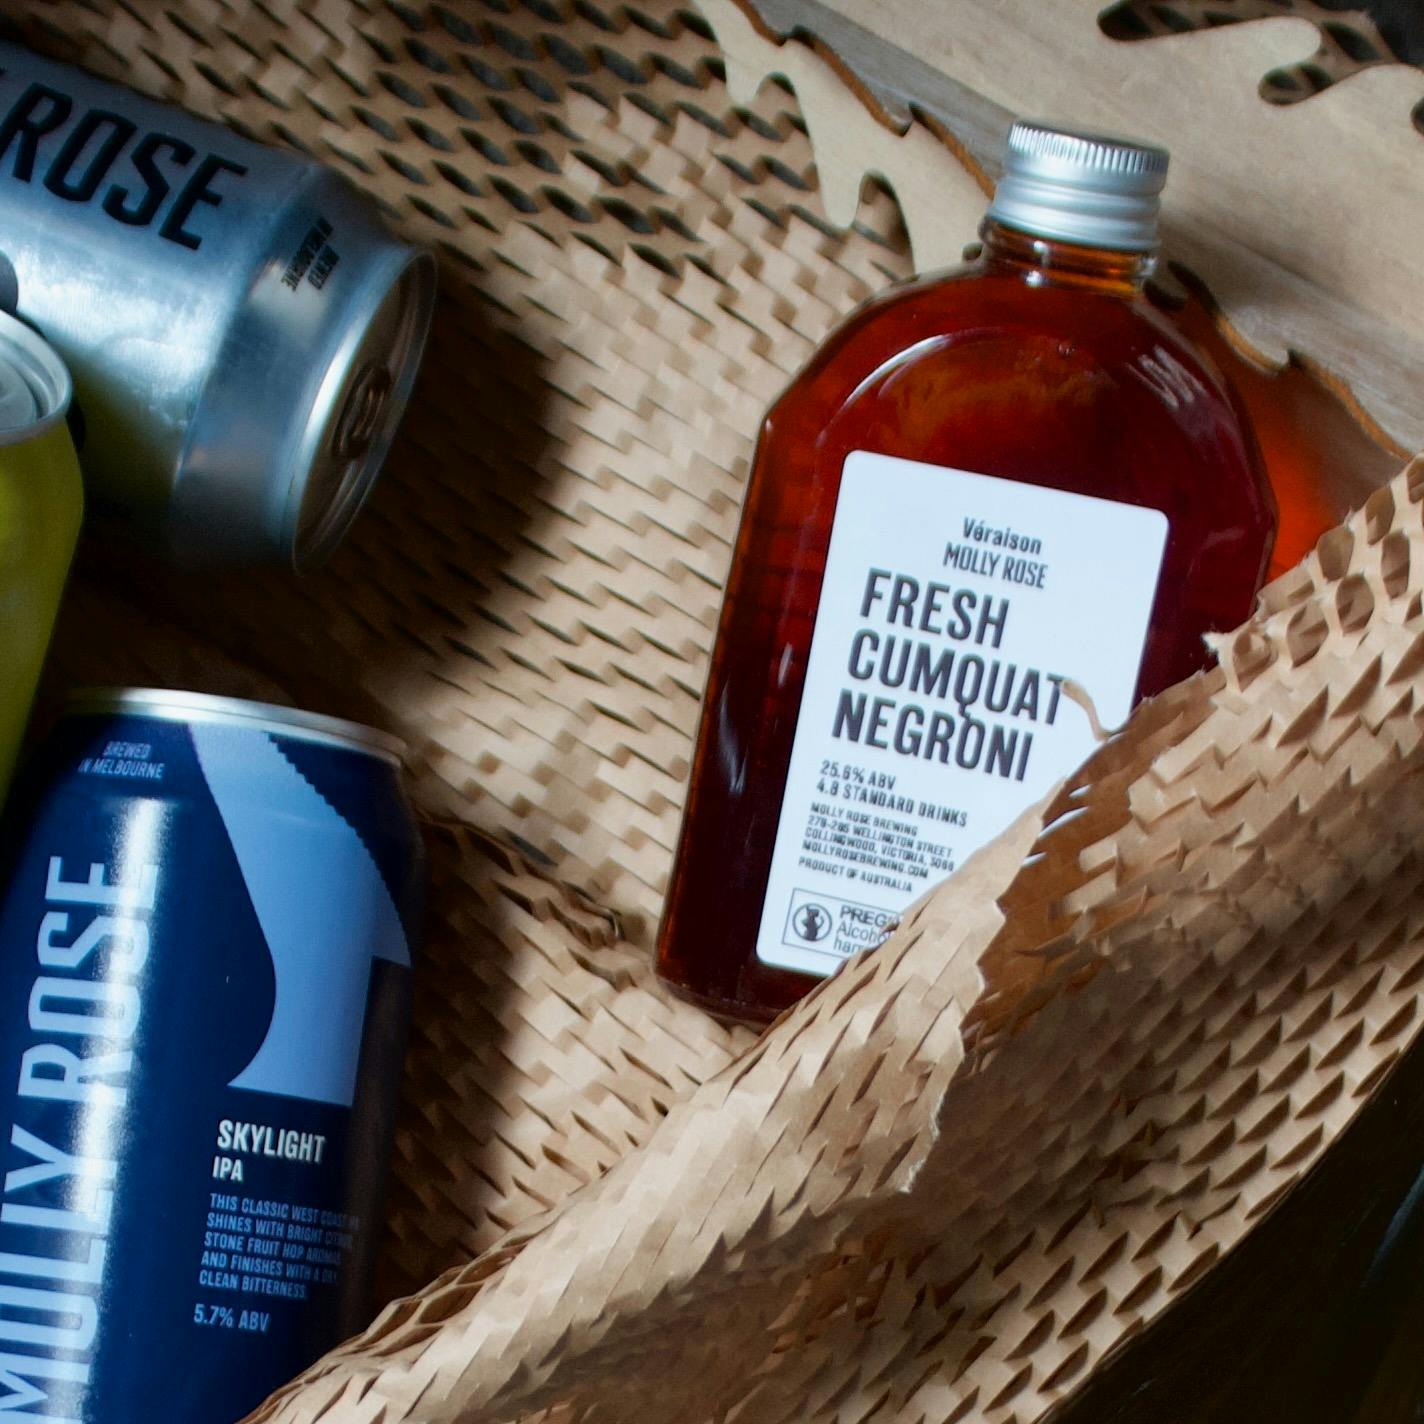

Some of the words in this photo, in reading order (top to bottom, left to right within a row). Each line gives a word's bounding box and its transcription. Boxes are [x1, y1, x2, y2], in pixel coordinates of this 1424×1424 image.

[963, 516, 1044, 556] Véraison
[942, 541, 1001, 579] MOLLY
[1001, 559, 1049, 590] ROSE
[859, 567, 1011, 649] FRESH
[847, 628, 1066, 727] CUMQUAT
[103, 741, 151, 759] BREWED
[831, 688, 1035, 783] NEGRONI
[92, 758, 164, 779] MELBOURNE
[868, 771, 896, 791] ABV
[810, 802, 844, 819] MOLLY
[846, 810, 872, 826] ROSE
[873, 817, 918, 837] BREWING
[817, 778, 839, 797] 4.8
[842, 784, 915, 815] STANDARD
[918, 801, 968, 828] DRINKS
[805, 827, 877, 855] COLLINGWOOD,
[881, 845, 928, 866] VICTORIA,
[853, 825, 914, 850] WELLINGTON
[916, 840, 953, 858] STREET
[799, 856, 844, 876] PRODUCT
[846, 867, 859, 880] OF
[860, 871, 912, 893] AUSTRALIA
[802, 840, 929, 879] MOLLYROSEBREWING.COM
[18, 856, 159, 1108] ROSE
[217, 1119, 326, 1163] SKYLIGHT
[212, 1156, 243, 1182] IPA
[210, 1193, 238, 1211] THIS
[242, 1198, 289, 1218] CLASSIC
[291, 1205, 318, 1223] WEST
[204, 1231, 244, 1251] STONE
[247, 1237, 280, 1255] FRUIT
[282, 1243, 305, 1258] HOP
[207, 1212, 252, 1232] SHINES
[256, 1219, 284, 1237] WITH
[287, 1223, 323, 1242] BRIGHT
[200, 1270, 238, 1289] CLEAN
[201, 1251, 226, 1268] AND
[230, 1254, 283, 1275] FINISHES
[286, 1262, 312, 1279] WITH
[313, 1268, 320, 1281] A
[194, 1303, 233, 1328] 5.7%
[238, 1309, 270, 1332] ABV
